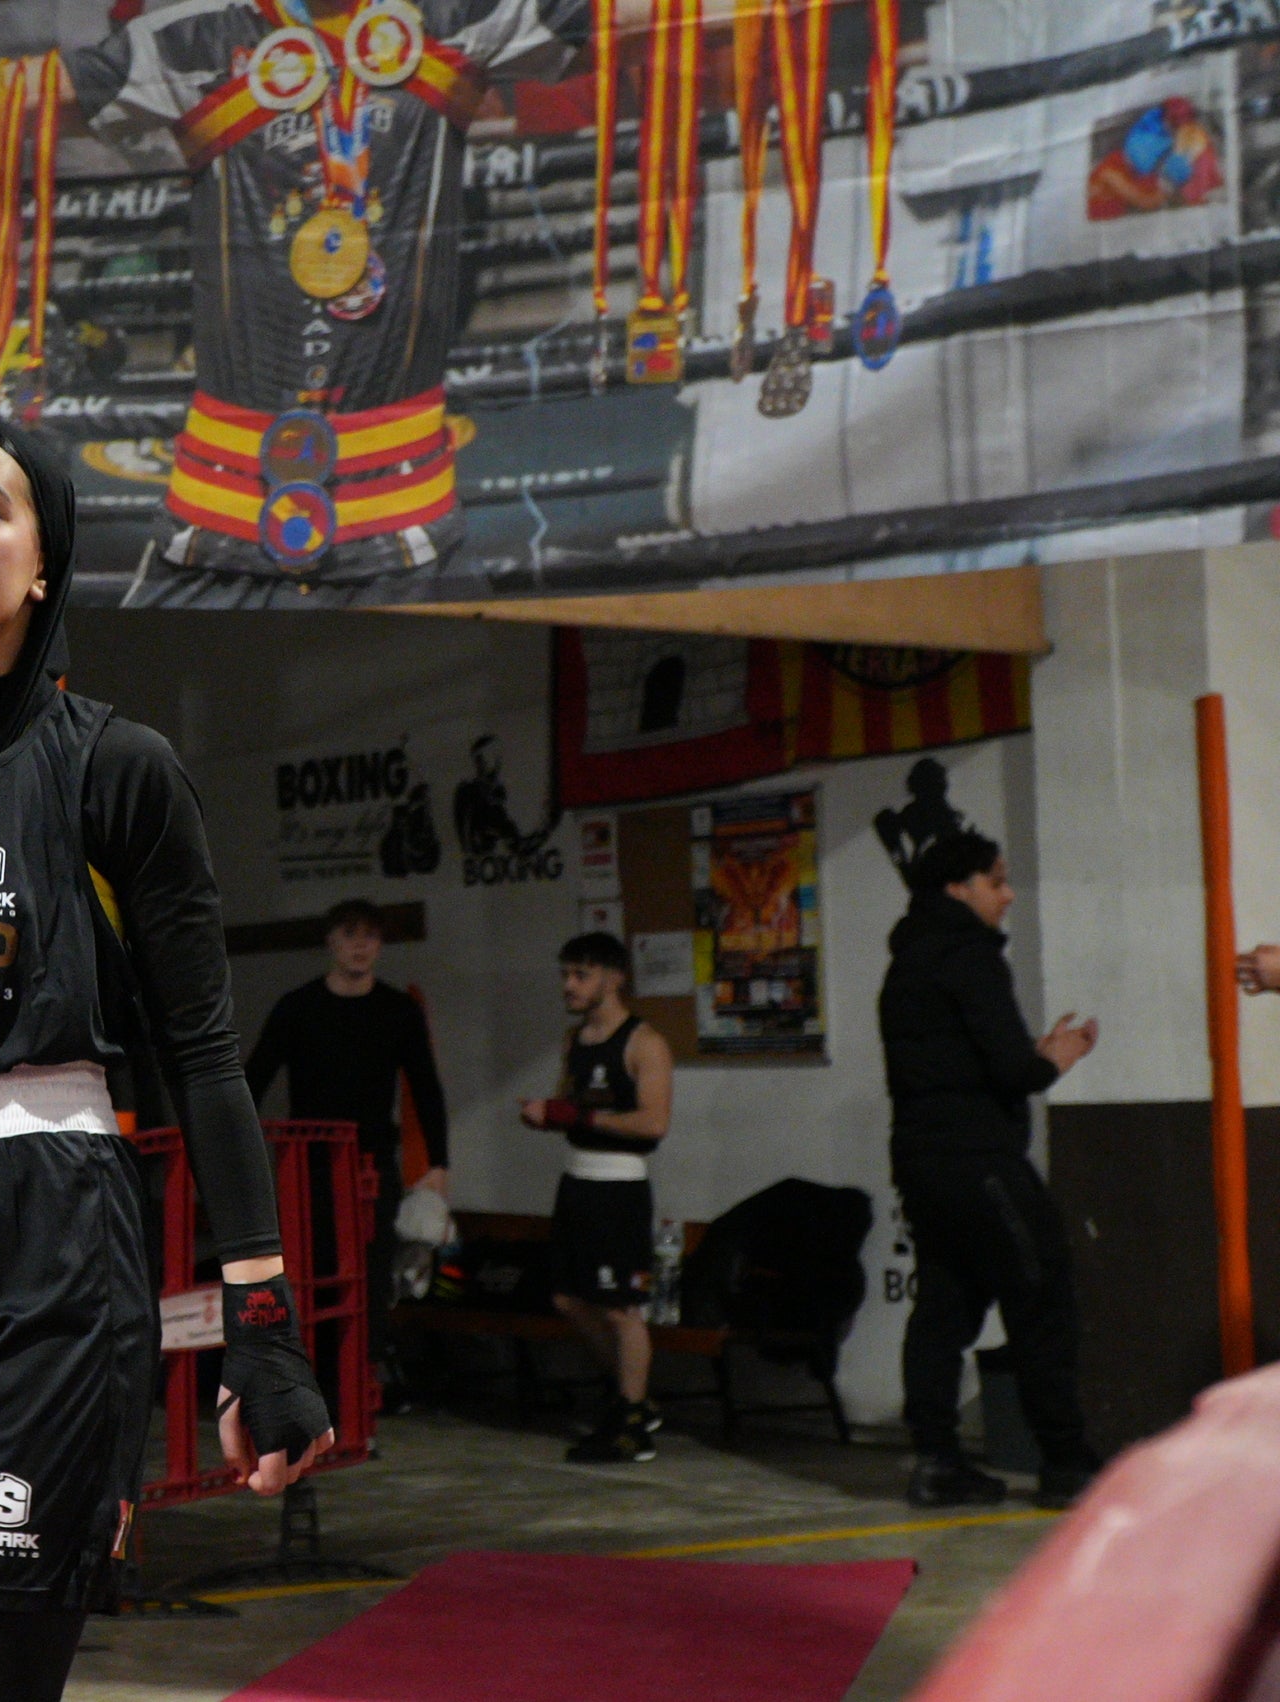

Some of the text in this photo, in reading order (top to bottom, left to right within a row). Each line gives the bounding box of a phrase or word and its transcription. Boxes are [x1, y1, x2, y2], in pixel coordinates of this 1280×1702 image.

[277, 749, 408, 810] BOXING
[464, 849, 563, 885] BOXING
[3, 985, 13, 1000] 3
[237, 1307, 288, 1327] VENUM
